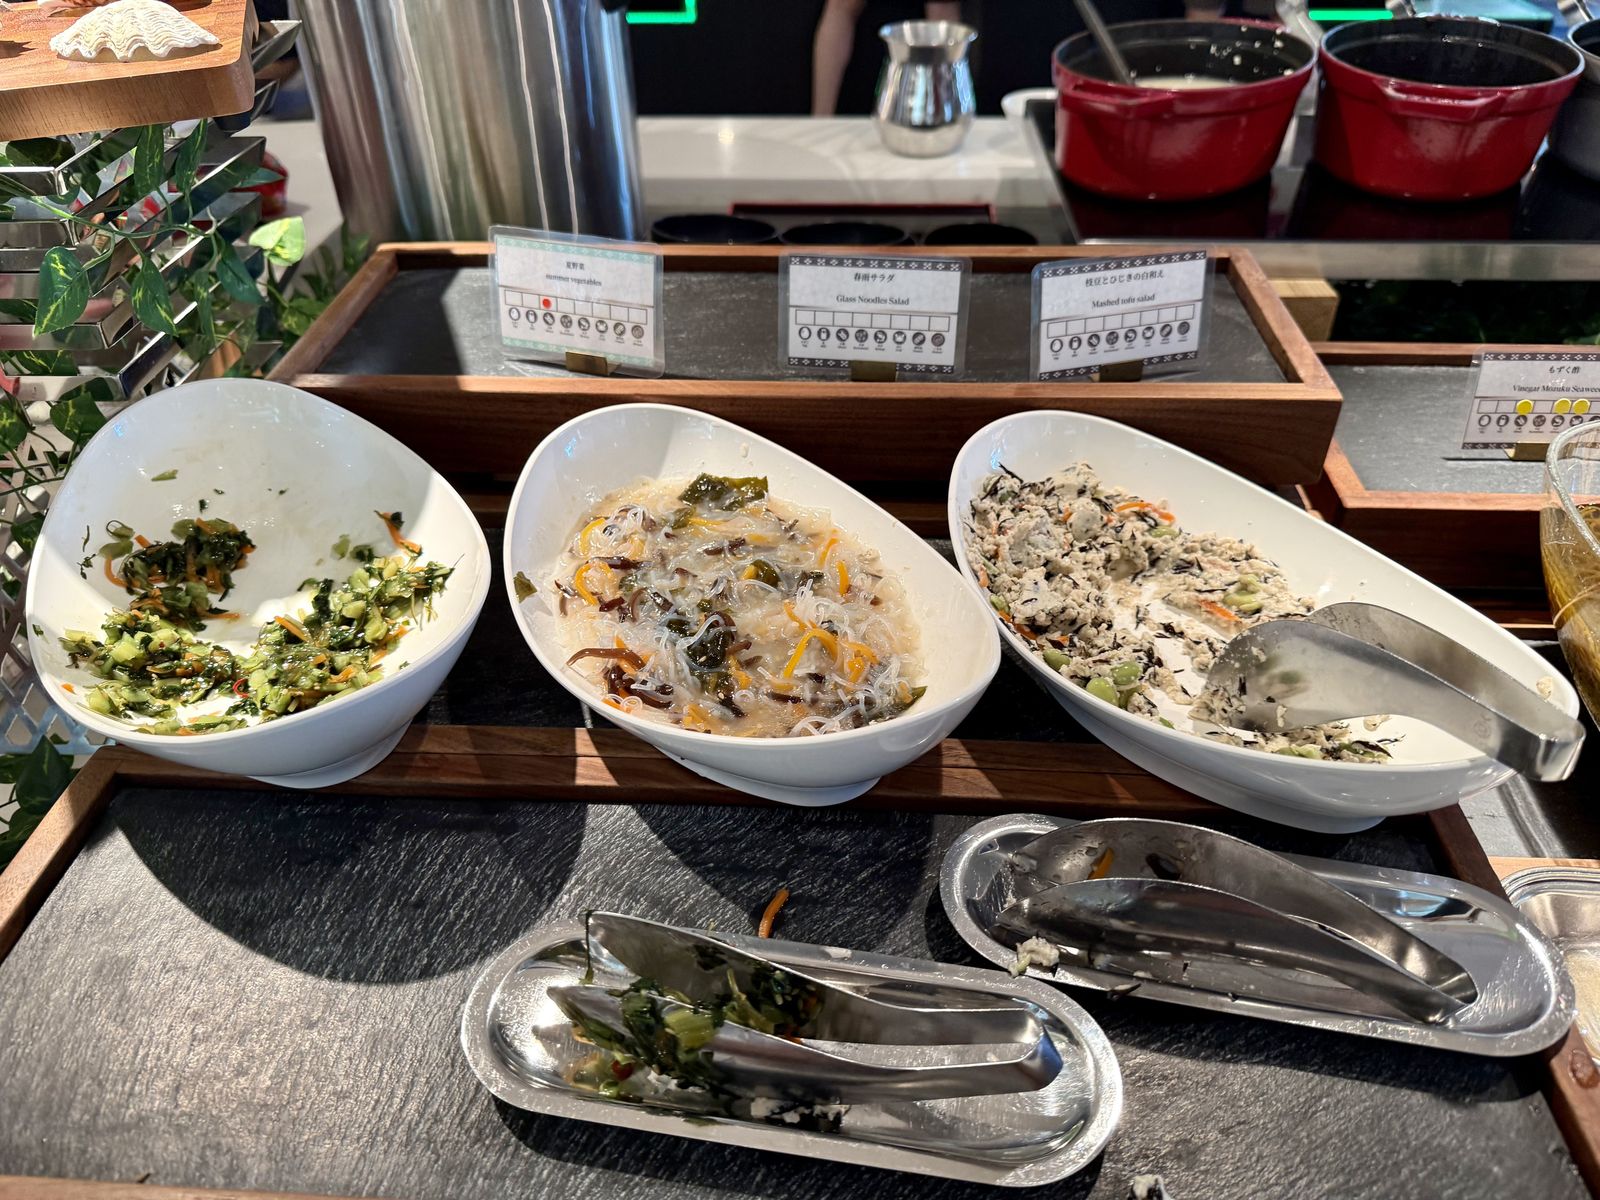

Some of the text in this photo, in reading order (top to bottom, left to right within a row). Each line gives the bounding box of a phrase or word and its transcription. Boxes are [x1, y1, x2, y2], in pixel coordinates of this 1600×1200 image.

[566, 261, 585, 270] 夏野菜
[545, 274, 602, 287] summer vegetables
[853, 272, 895, 283] 春雨サラダ
[1085, 270, 1164, 287] 枝豆とひじきの白和え
[836, 295, 910, 306] Glass Noodles Salad
[1092, 297, 1120, 308] Mashed
[1136, 294, 1156, 304] salad
[1549, 365, 1580, 374] もずく酢
[1513, 385, 1540, 394] Vinegar
[1542, 385, 1571, 393] Mozuku
